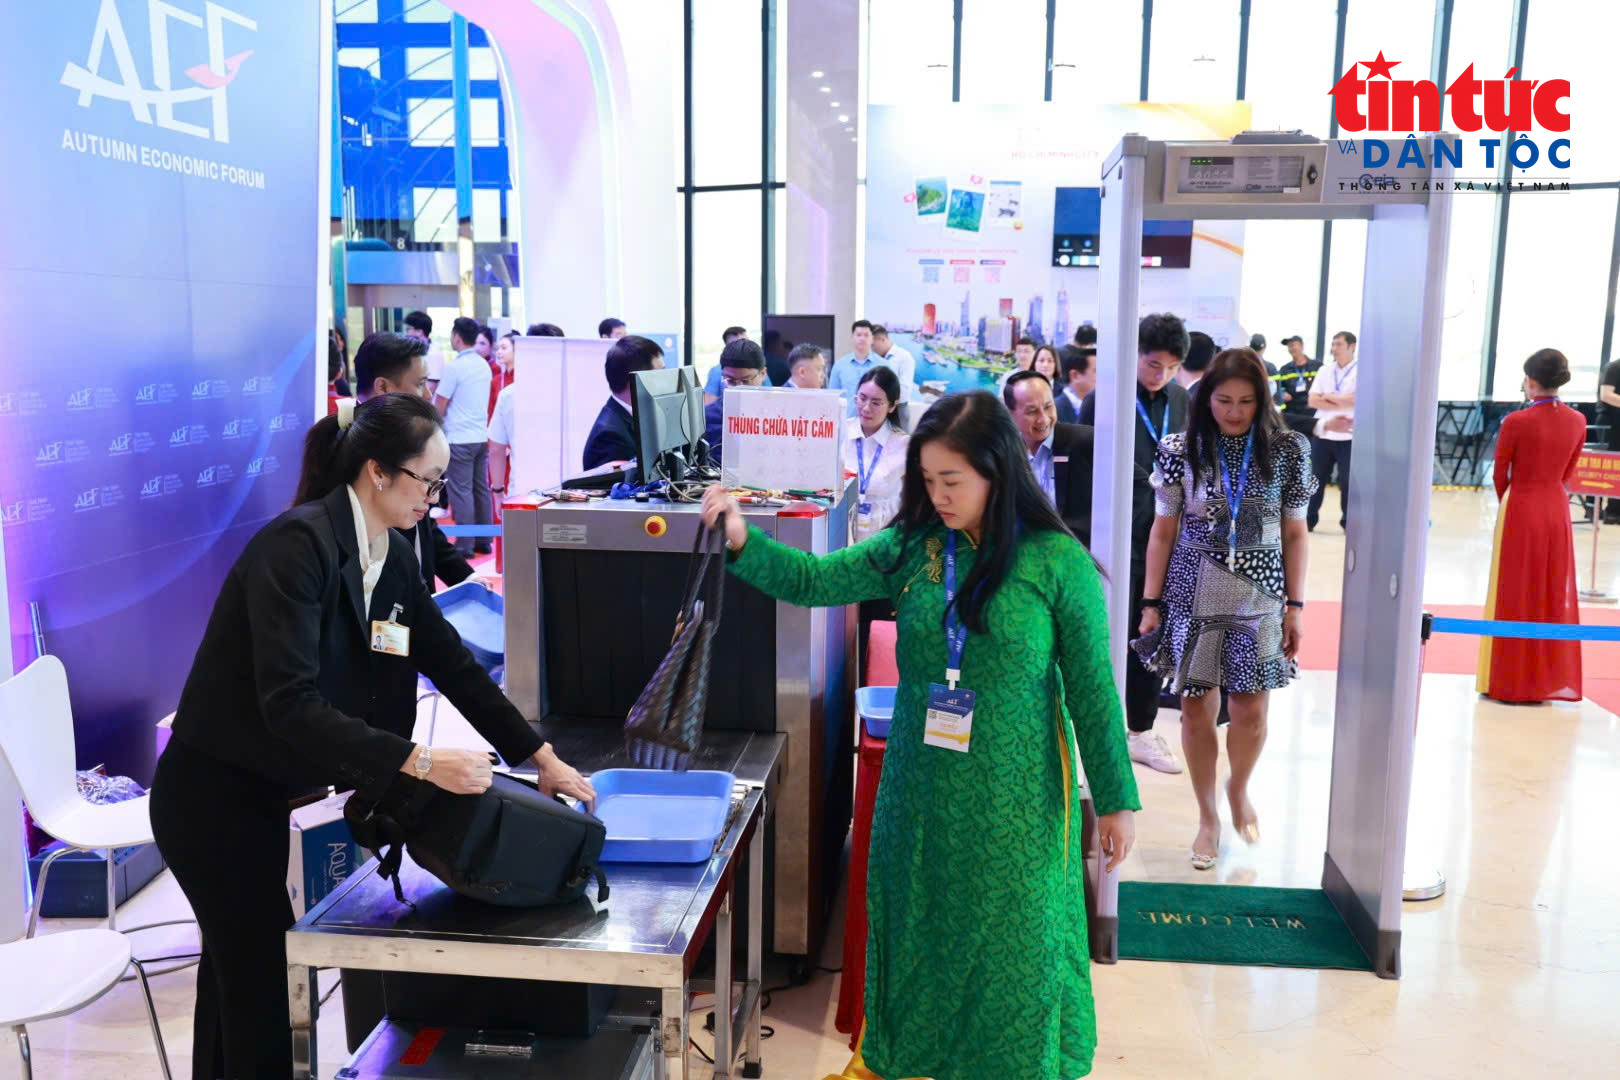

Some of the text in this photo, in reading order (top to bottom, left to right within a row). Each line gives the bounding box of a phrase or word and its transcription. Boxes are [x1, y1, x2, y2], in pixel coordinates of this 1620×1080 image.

[61, 129, 265, 190] AUTUMN ECONOMIC FORUM
[762, 414, 788, 437] CHỨA
[791, 416, 808, 440] VẬT
[811, 415, 834, 438] CẤM
